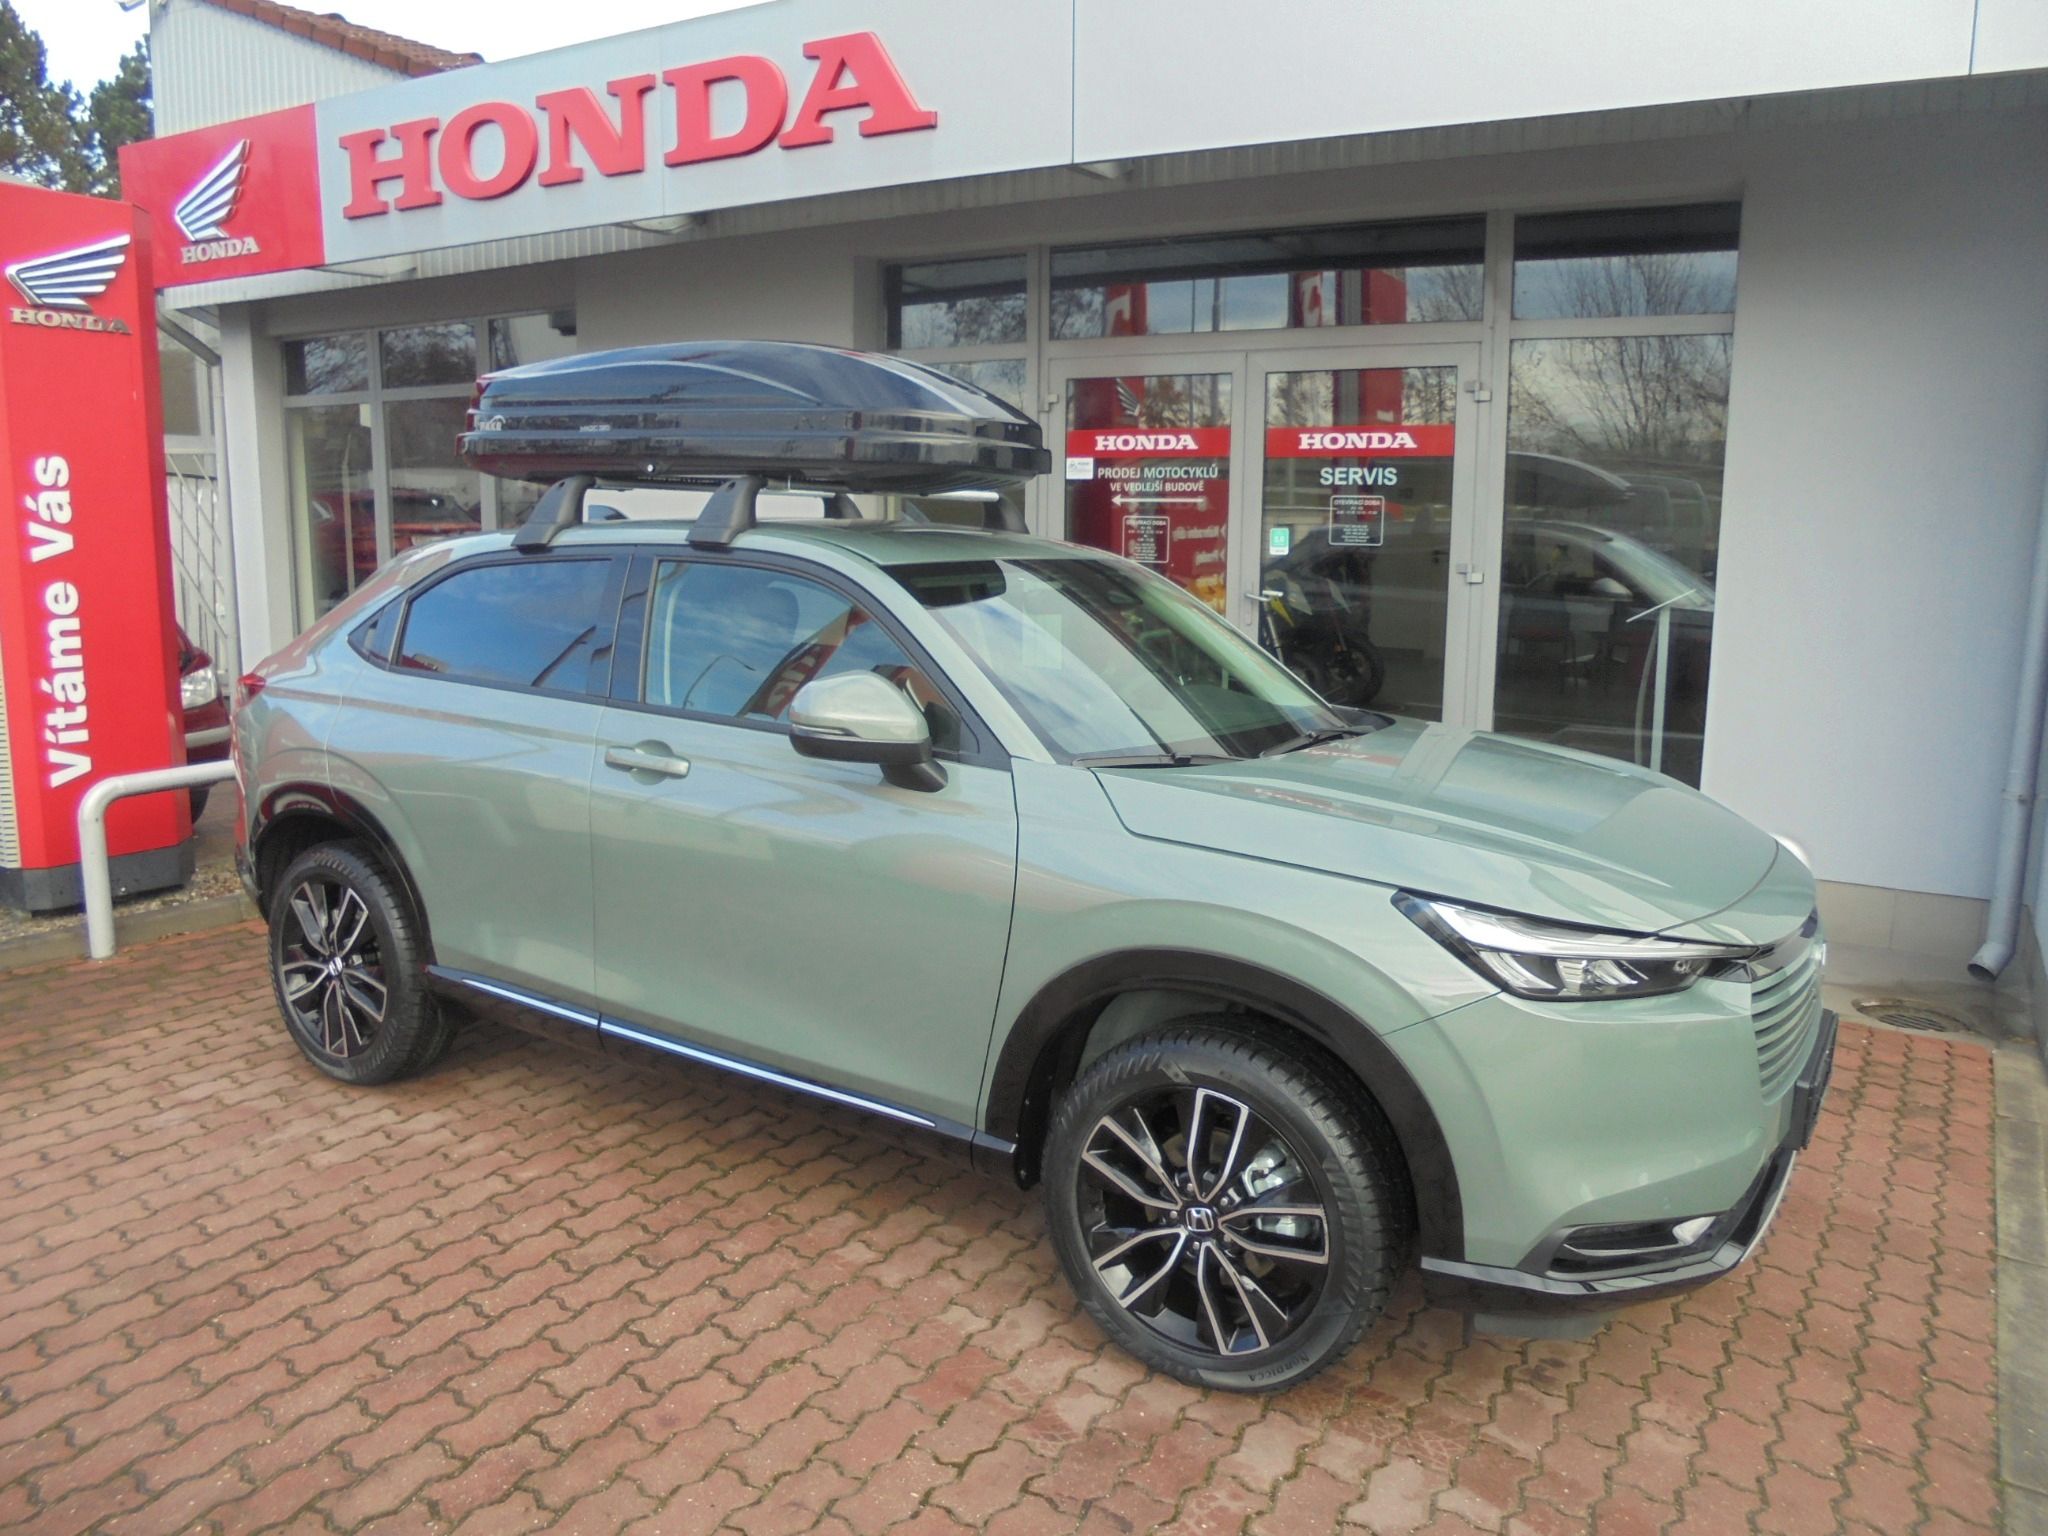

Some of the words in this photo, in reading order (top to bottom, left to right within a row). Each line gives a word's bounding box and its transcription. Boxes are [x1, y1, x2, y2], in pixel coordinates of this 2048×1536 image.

[339, 31, 937, 219] HONDA
[181, 236, 260, 264] HONDA
[10, 307, 132, 335] HONDA
[1095, 434, 1198, 450] HONDA
[1299, 432, 1417, 449] HONDA
[1098, 467, 1141, 478] PRODEJ
[1143, 464, 1218, 478] MOTOCYKLŮ
[1320, 467, 1397, 486] SERVIS
[1110, 482, 1121, 492] VE
[1124, 481, 1163, 492] VEDLEJŠÍ
[25, 455, 74, 563] Vás
[41, 581, 92, 788] Vítáme
